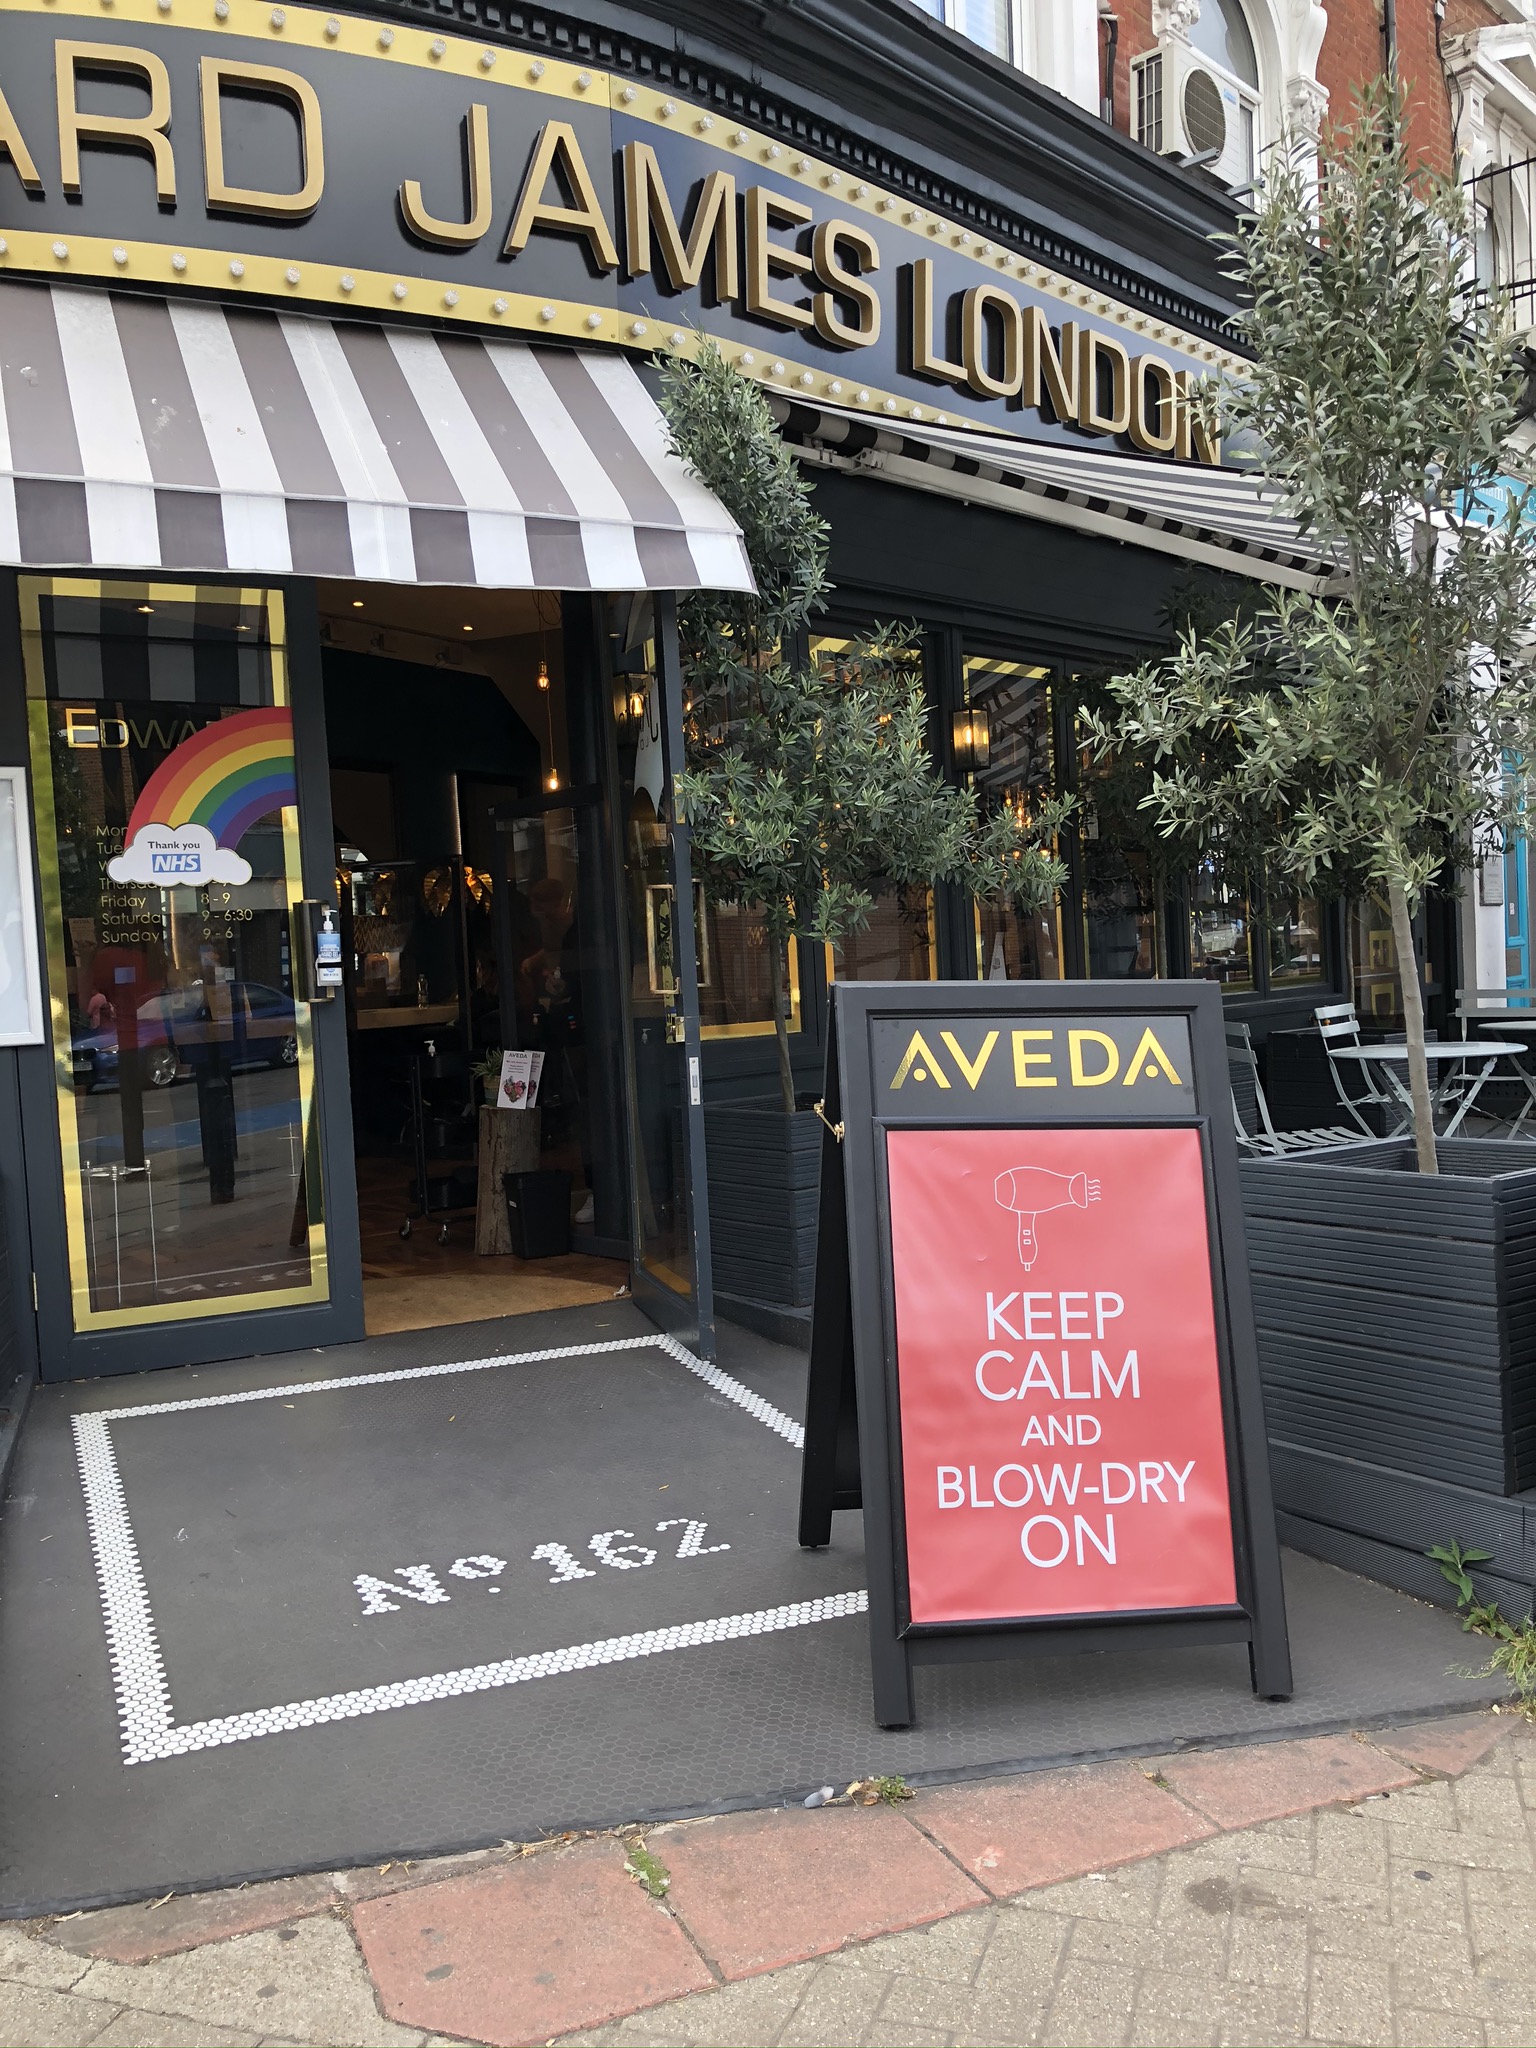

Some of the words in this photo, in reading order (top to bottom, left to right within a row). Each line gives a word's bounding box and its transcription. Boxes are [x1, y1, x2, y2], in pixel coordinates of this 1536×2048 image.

[400, 104, 881, 350] JAMES
[914, 258, 1221, 466] LONDON
[65, 708, 217, 749] EDWA
[96, 825, 128, 837] Mon
[96, 842, 122, 855] Tue
[147, 841, 180, 850] Thank
[182, 843, 201, 852] you
[153, 854, 200, 872] NHS
[101, 895, 146, 909] Friday
[201, 893, 210, 904] 8
[222, 893, 231, 904] 9
[102, 911, 162, 925] Saturda
[201, 910, 210, 922] 9
[224, 909, 253, 921] 6:30
[102, 930, 160, 943] Sunday
[203, 928, 211, 940] 9
[225, 927, 234, 939] 6
[890, 1026, 1183, 1090] AVEDA
[986, 1291, 1125, 1341] KEEP
[975, 1349, 1141, 1402] CALM
[1020, 1414, 1102, 1447] AND
[936, 1460, 1196, 1510] BLOW-DRY
[531, 1518, 731, 1584] 162
[1020, 1514, 1117, 1569] ON
